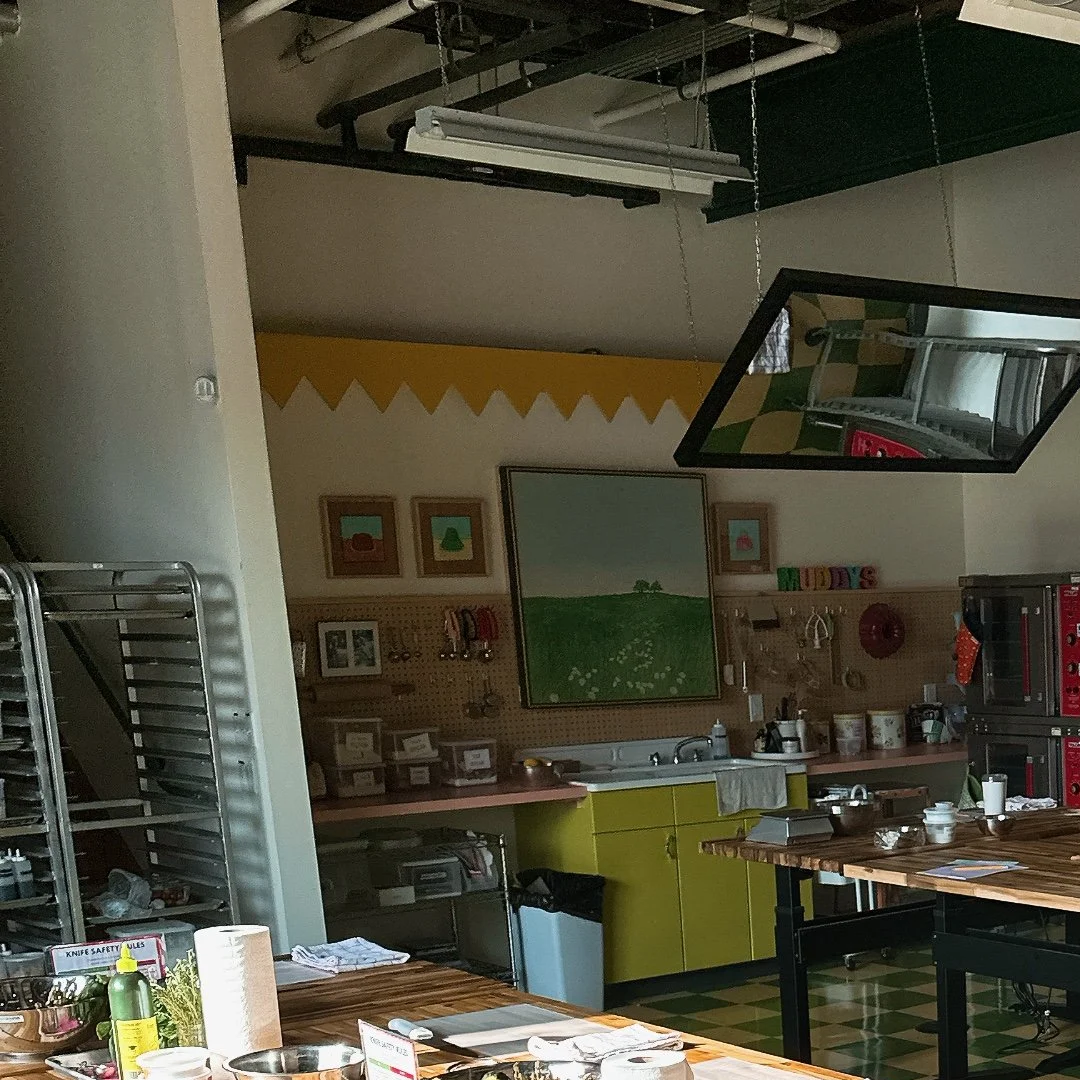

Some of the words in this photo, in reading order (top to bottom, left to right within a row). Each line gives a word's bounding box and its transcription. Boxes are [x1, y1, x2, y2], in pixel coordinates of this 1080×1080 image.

[777, 566, 878, 591] MUDDYS
[66, 948, 89, 958] KNIFE
[91, 944, 120, 955] SAFETY
[122, 941, 145, 951] ULES
